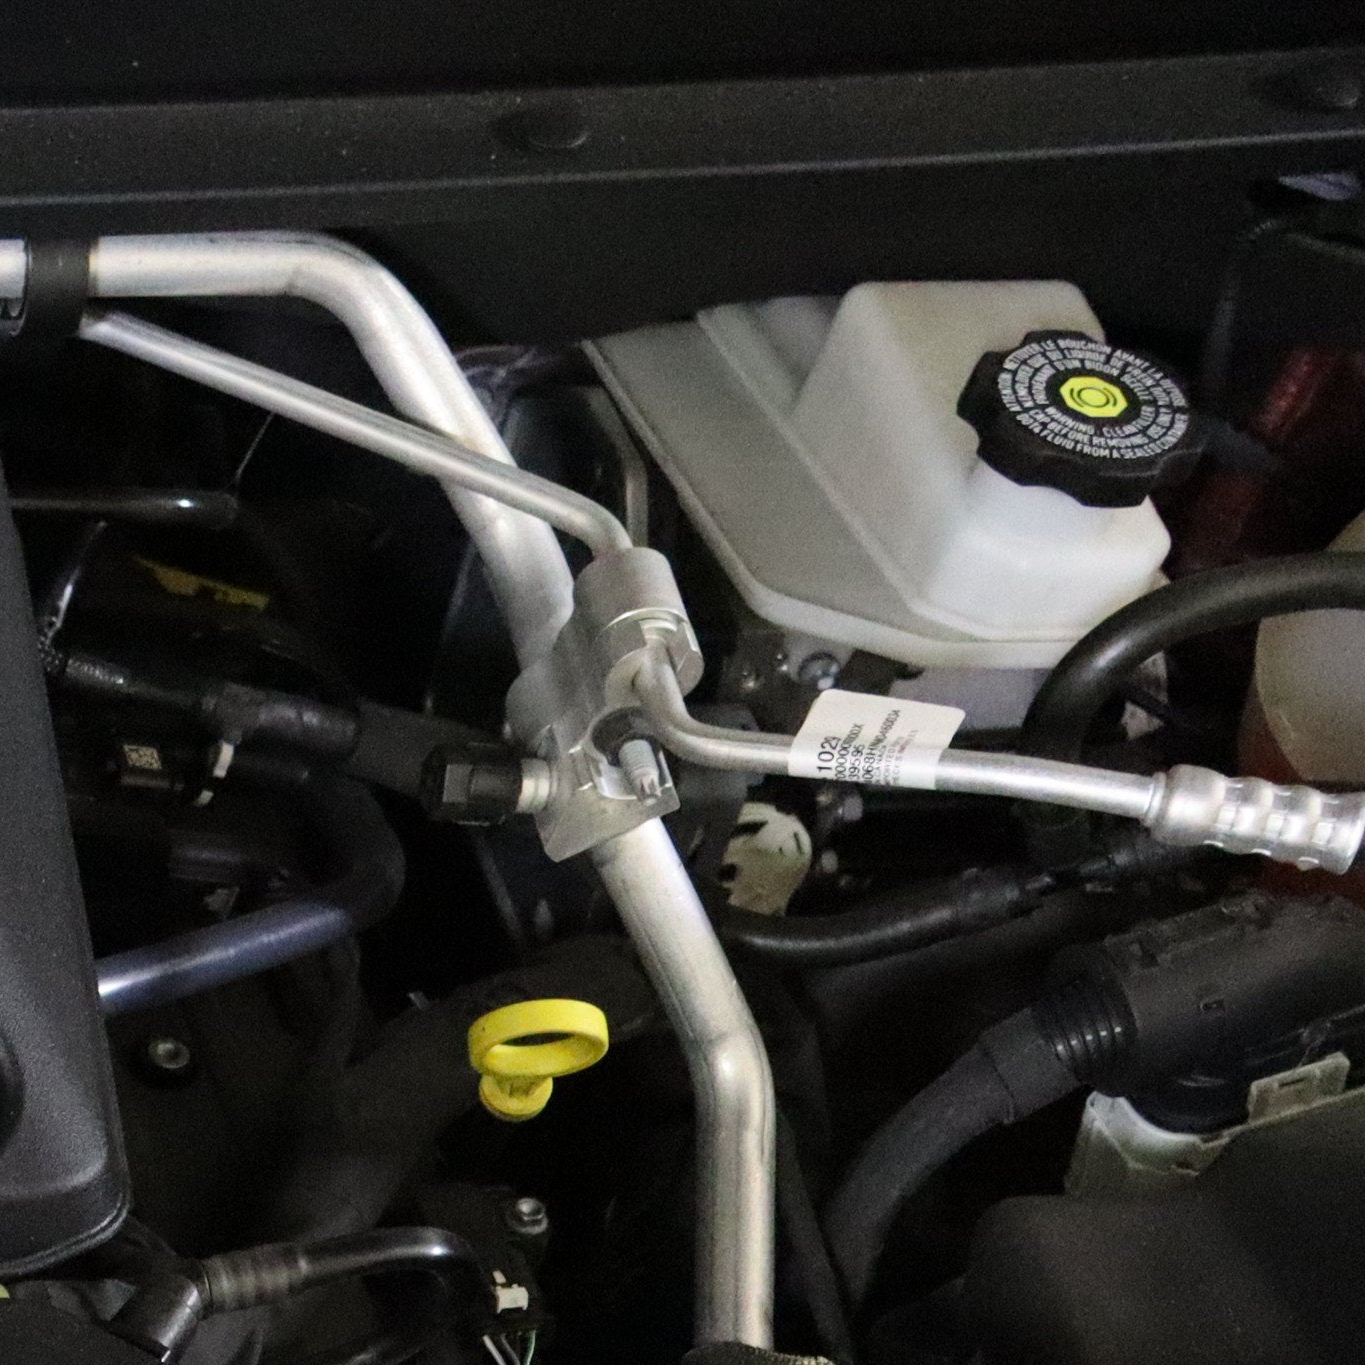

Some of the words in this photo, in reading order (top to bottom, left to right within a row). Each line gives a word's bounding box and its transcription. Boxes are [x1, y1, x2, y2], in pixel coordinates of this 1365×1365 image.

[1112, 349, 1150, 370] AVANT
[1147, 367, 1164, 380] LA
[1028, 409, 1051, 423] CAP
[1047, 421, 1090, 444] BEFORE
[1039, 429, 1075, 449] FLUID
[1075, 443, 1110, 459] FROM
